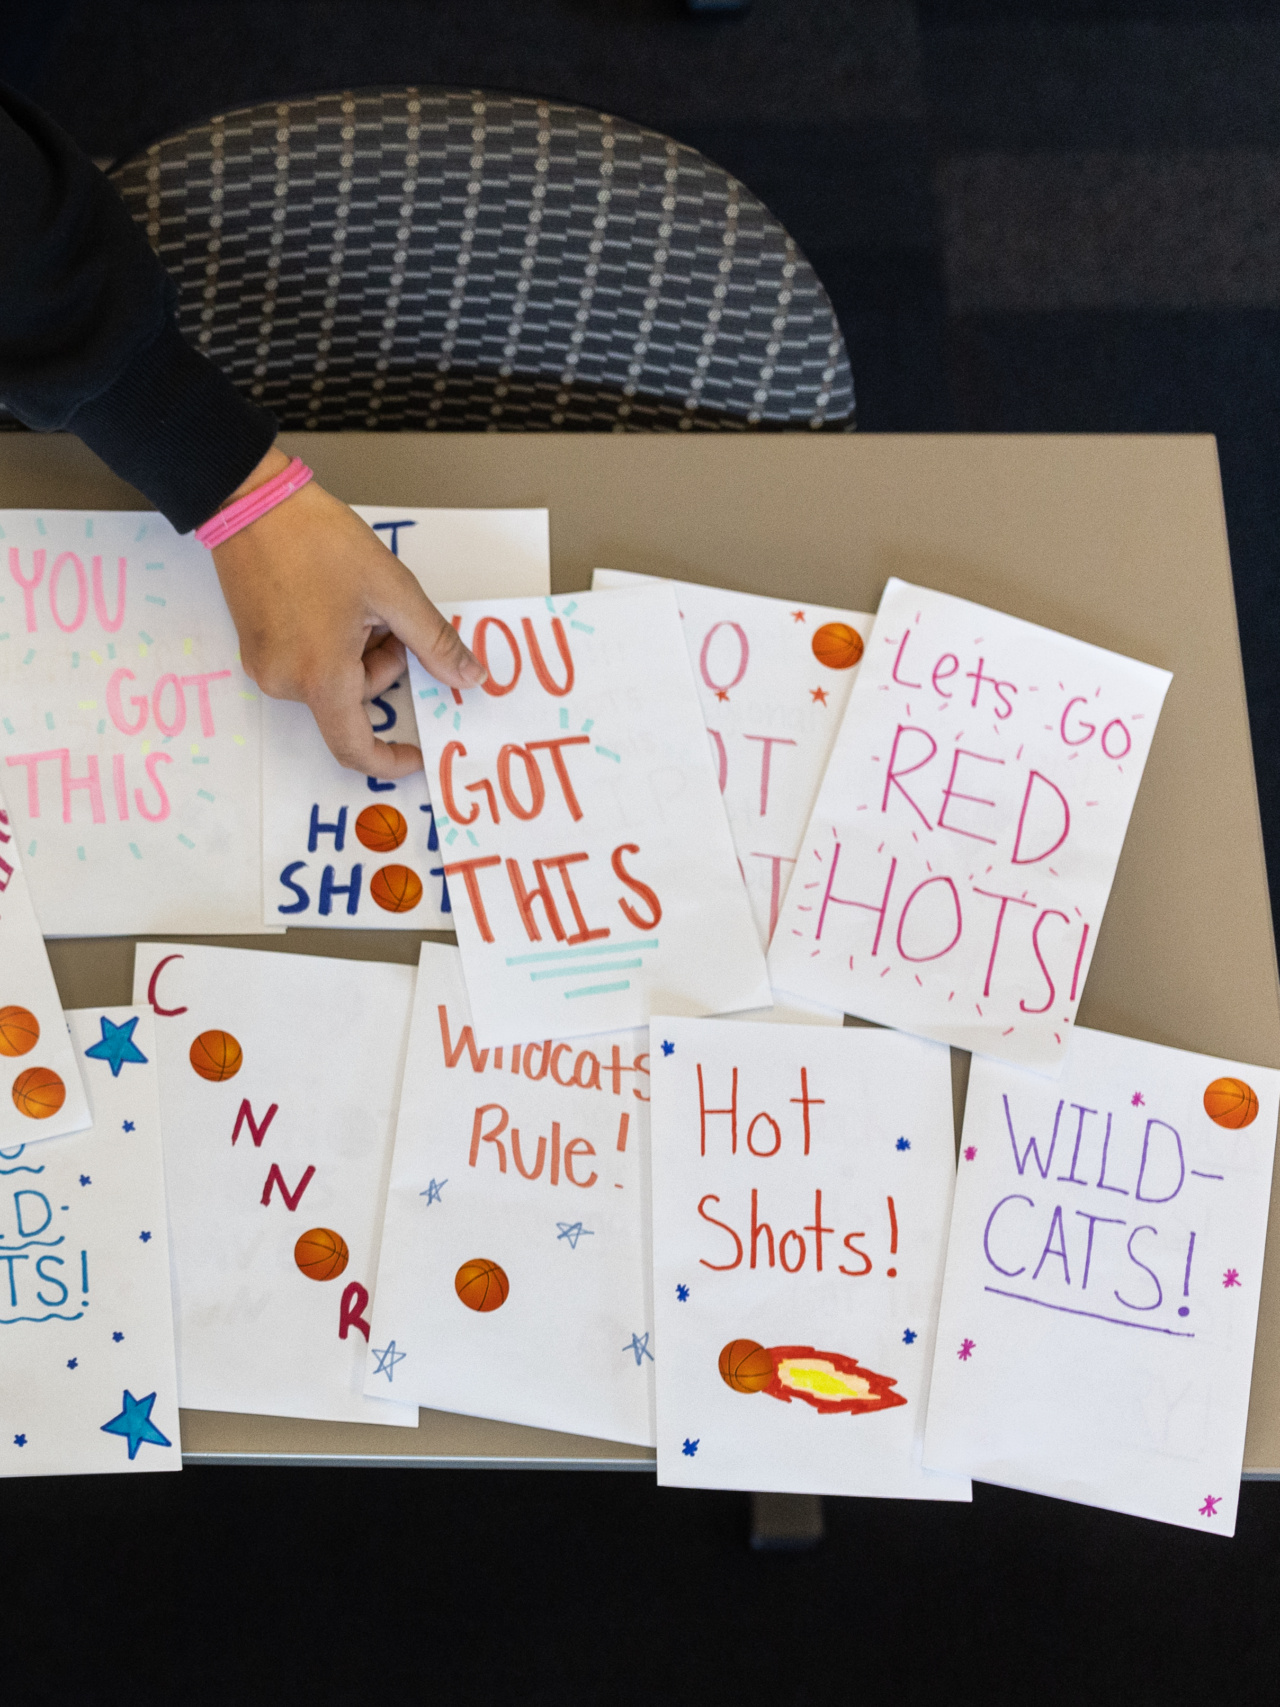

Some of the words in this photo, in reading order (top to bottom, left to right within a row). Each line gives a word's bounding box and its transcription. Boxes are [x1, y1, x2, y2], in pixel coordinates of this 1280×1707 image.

[8, 546, 127, 634] YOU
[105, 667, 233, 739] GOT
[893, 629, 1018, 719] Lets
[5, 748, 174, 825] THIS
[438, 736, 591, 826] GOT
[882, 723, 1072, 866] RED
[278, 860, 452, 916] SHOT
[444, 843, 663, 945] THIS
[814, 842, 1091, 1024] HOTS!
[468, 1102, 631, 1190] Rule!
[696, 1062, 826, 1158] Hot
[1001, 1093, 1225, 1204] WILD-
[696, 1187, 899, 1279] Shots!
[982, 1193, 1197, 1319] CATS!
